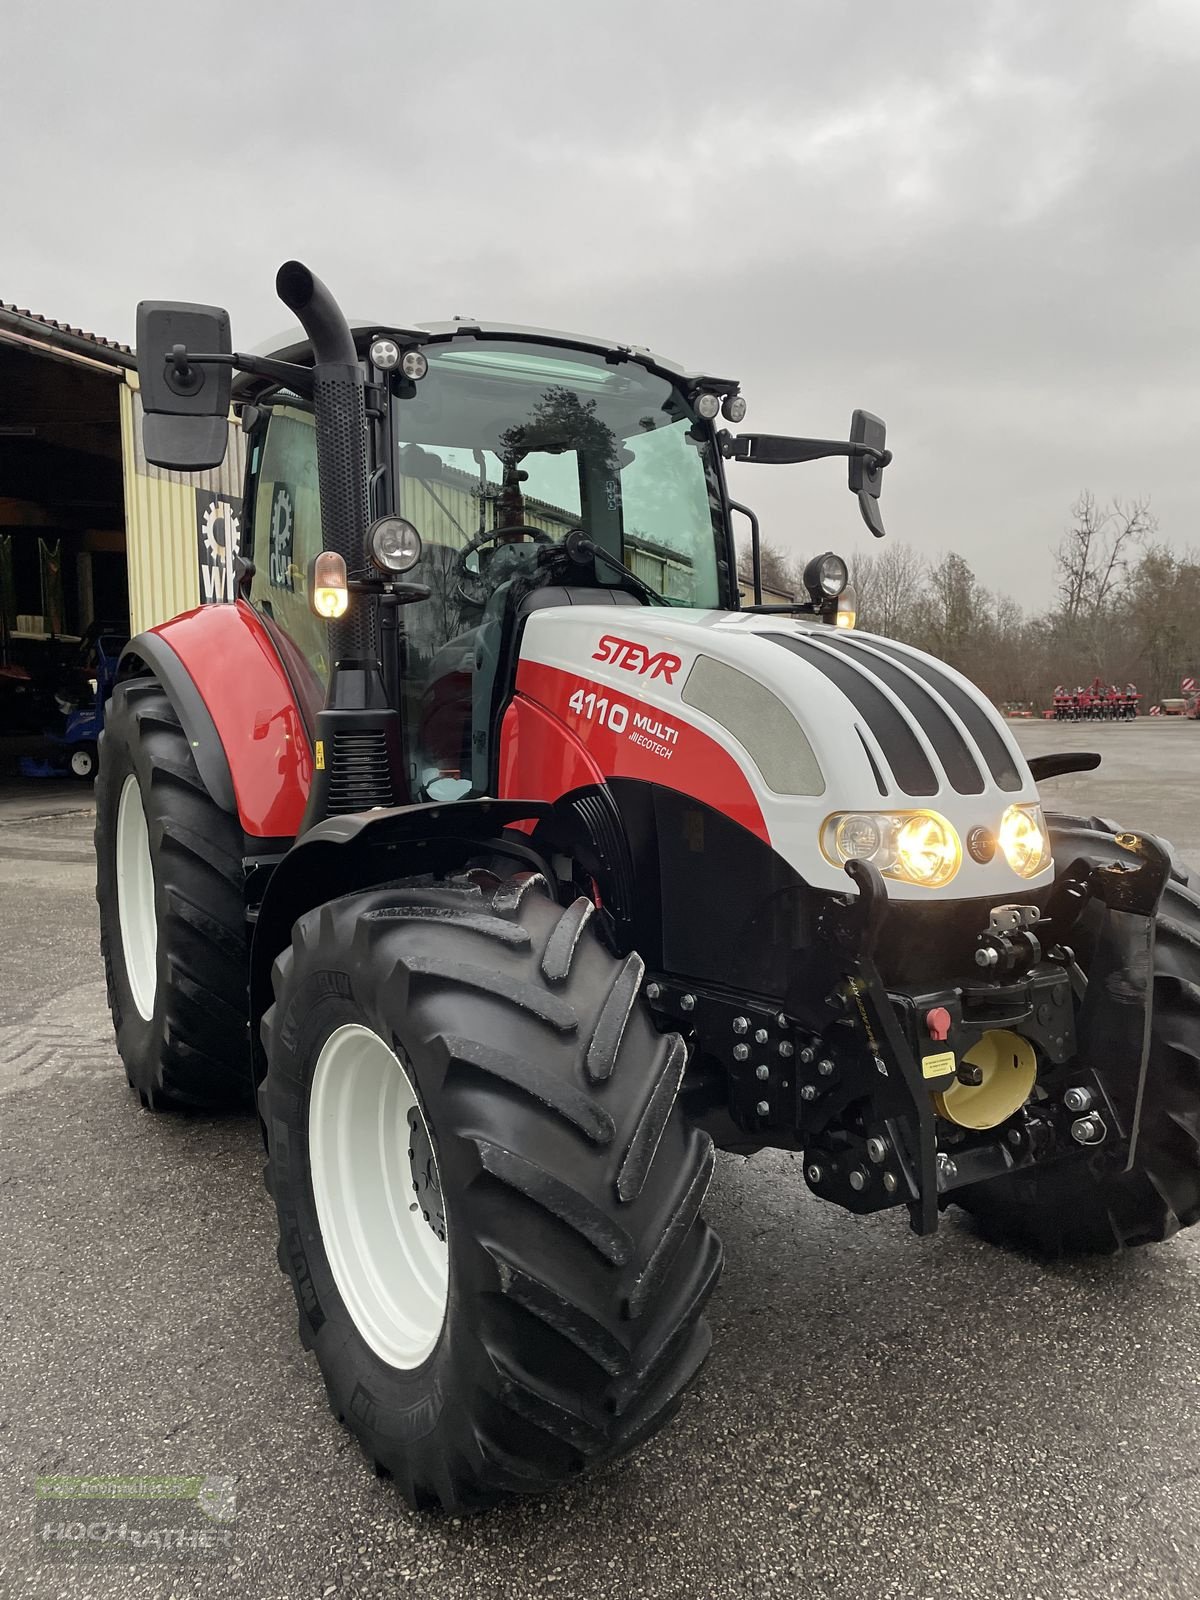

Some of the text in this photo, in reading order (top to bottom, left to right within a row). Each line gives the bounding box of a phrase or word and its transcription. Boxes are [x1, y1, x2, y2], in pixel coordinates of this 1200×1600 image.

[592, 634, 682, 685] STEYR
[568, 689, 679, 744] 4110 MULTI
